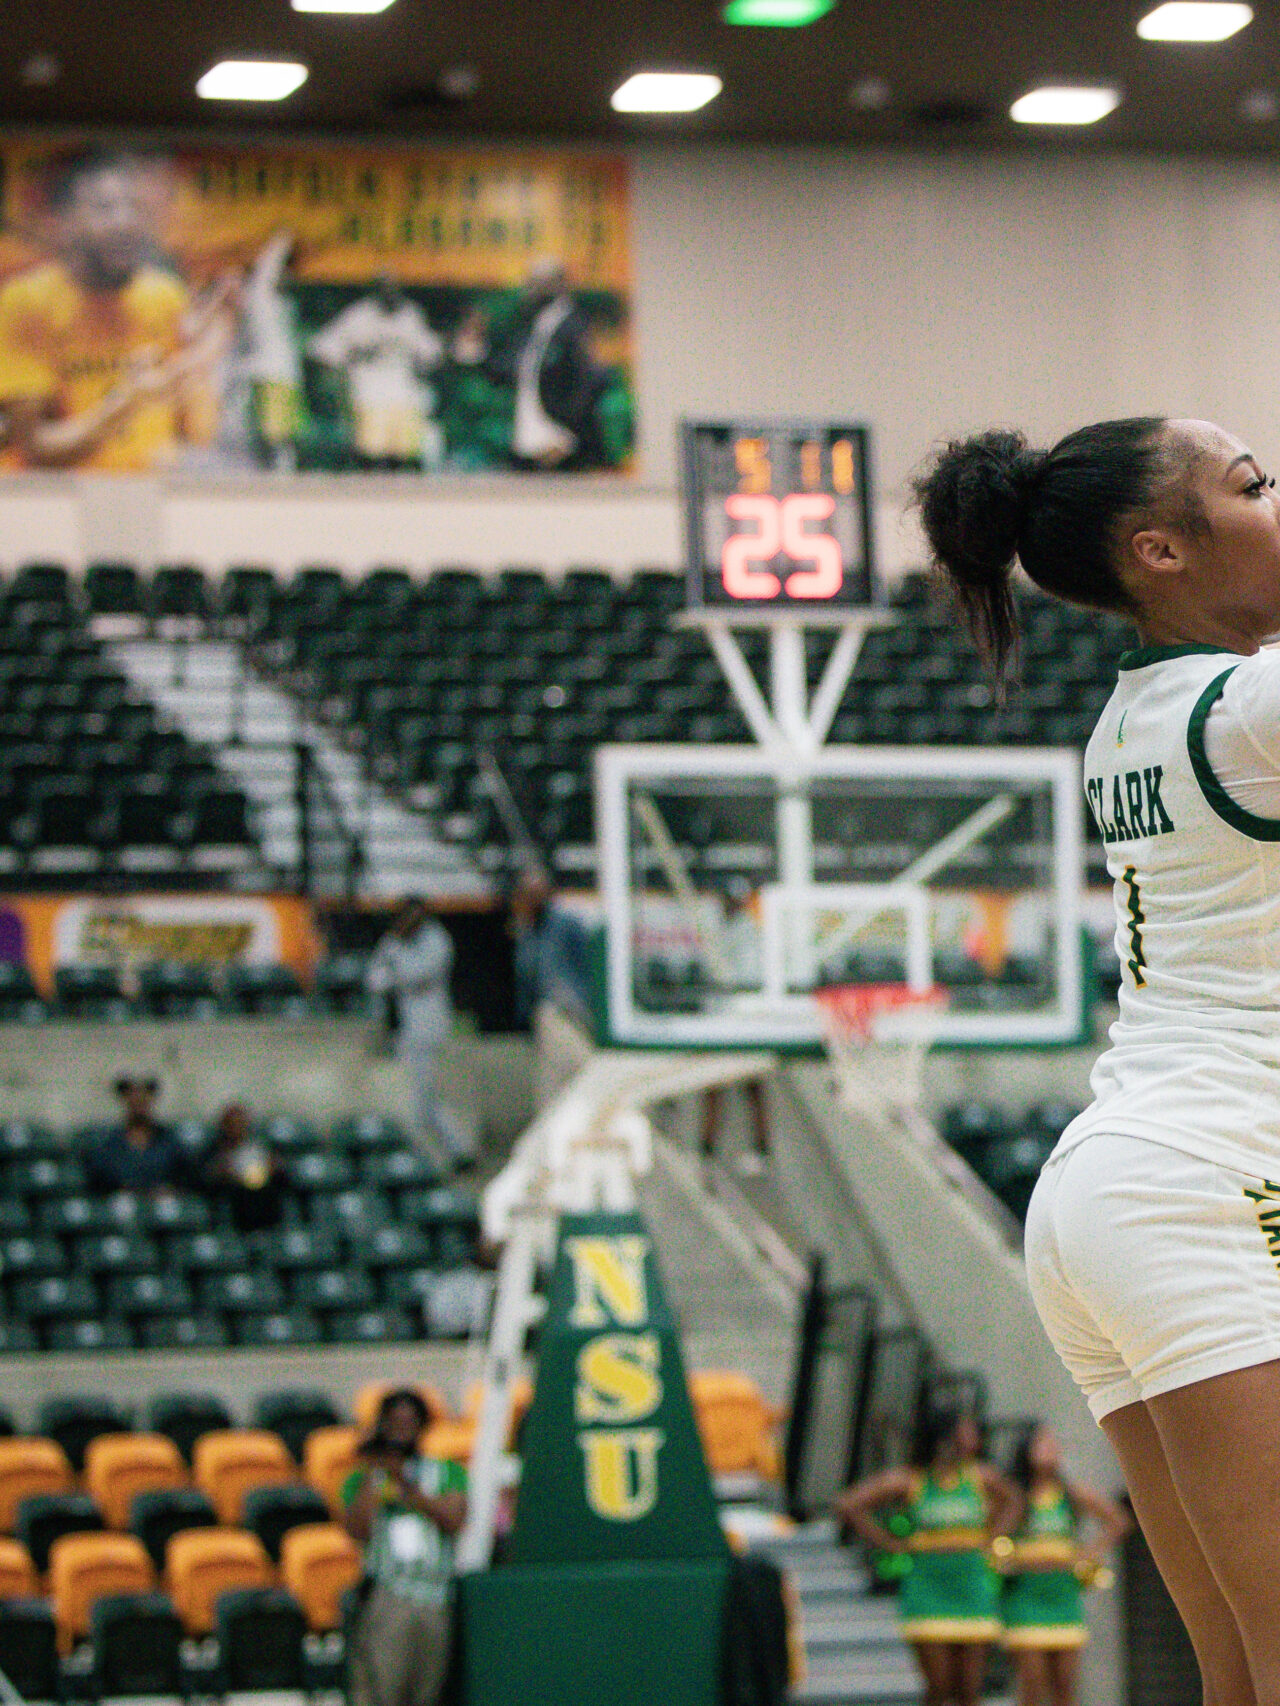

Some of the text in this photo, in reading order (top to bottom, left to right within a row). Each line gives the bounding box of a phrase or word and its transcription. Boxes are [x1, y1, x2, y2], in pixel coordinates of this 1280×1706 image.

[721, 493, 843, 599] 25
[1087, 764, 1175, 844] CLARK
[563, 1235, 667, 1523] NSU
